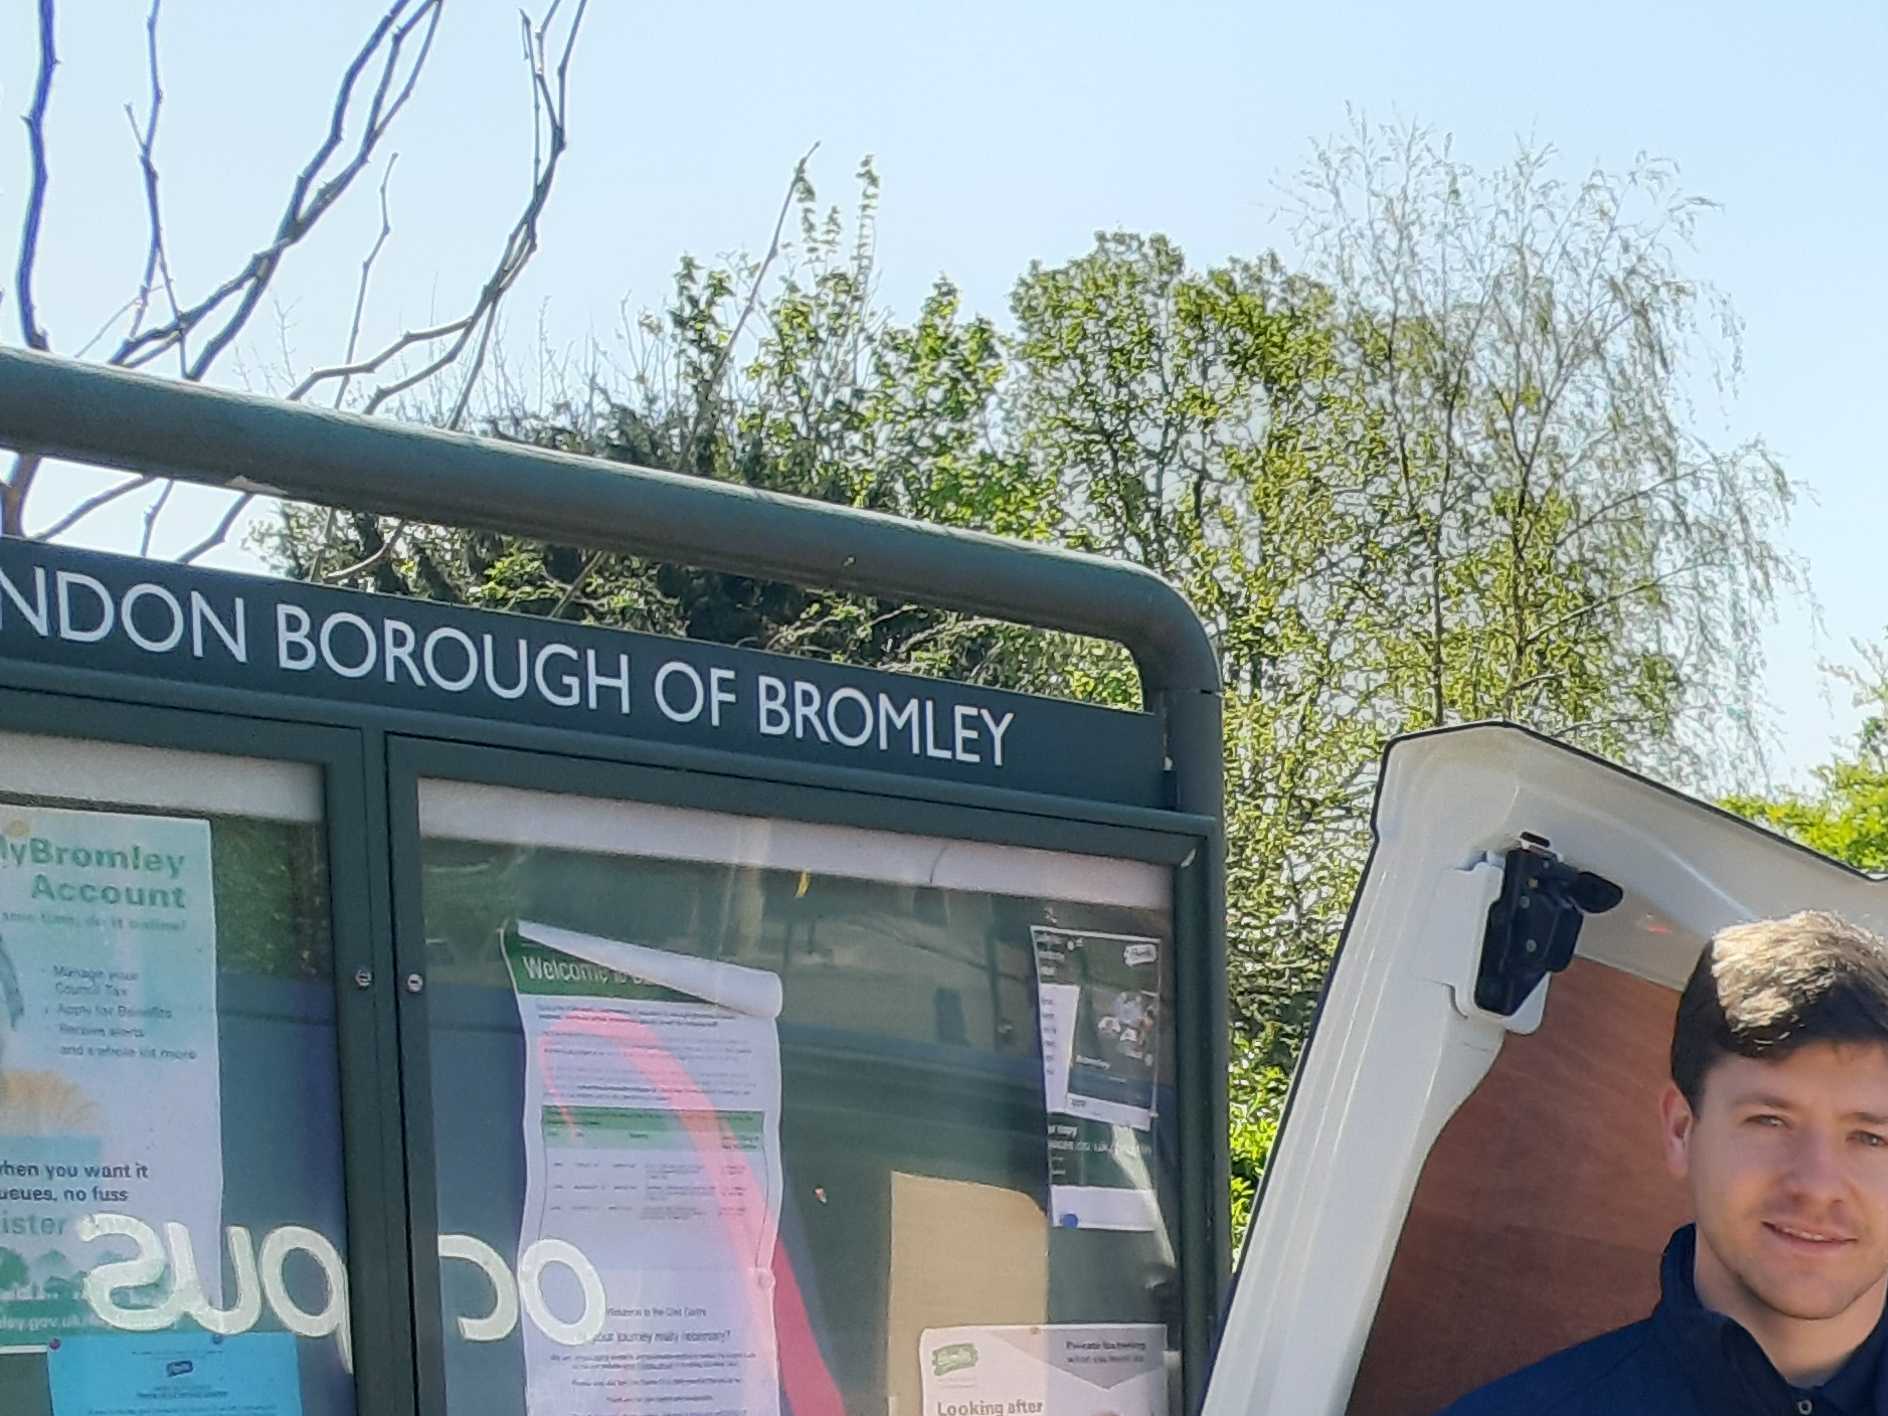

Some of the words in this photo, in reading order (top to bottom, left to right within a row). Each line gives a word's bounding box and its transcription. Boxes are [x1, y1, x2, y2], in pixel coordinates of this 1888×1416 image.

[276, 604, 631, 714] BOROUGH
[654, 661, 736, 726] OF
[758, 675, 1014, 766] BROMLEY
[31, 873, 186, 909] Account
[46, 1164, 79, 1181] you
[84, 1163, 131, 1179] want
[135, 1160, 150, 1179] it
[64, 1190, 87, 1202] no
[92, 1186, 129, 1202] fuss
[1008, 1400, 1043, 1415] after
